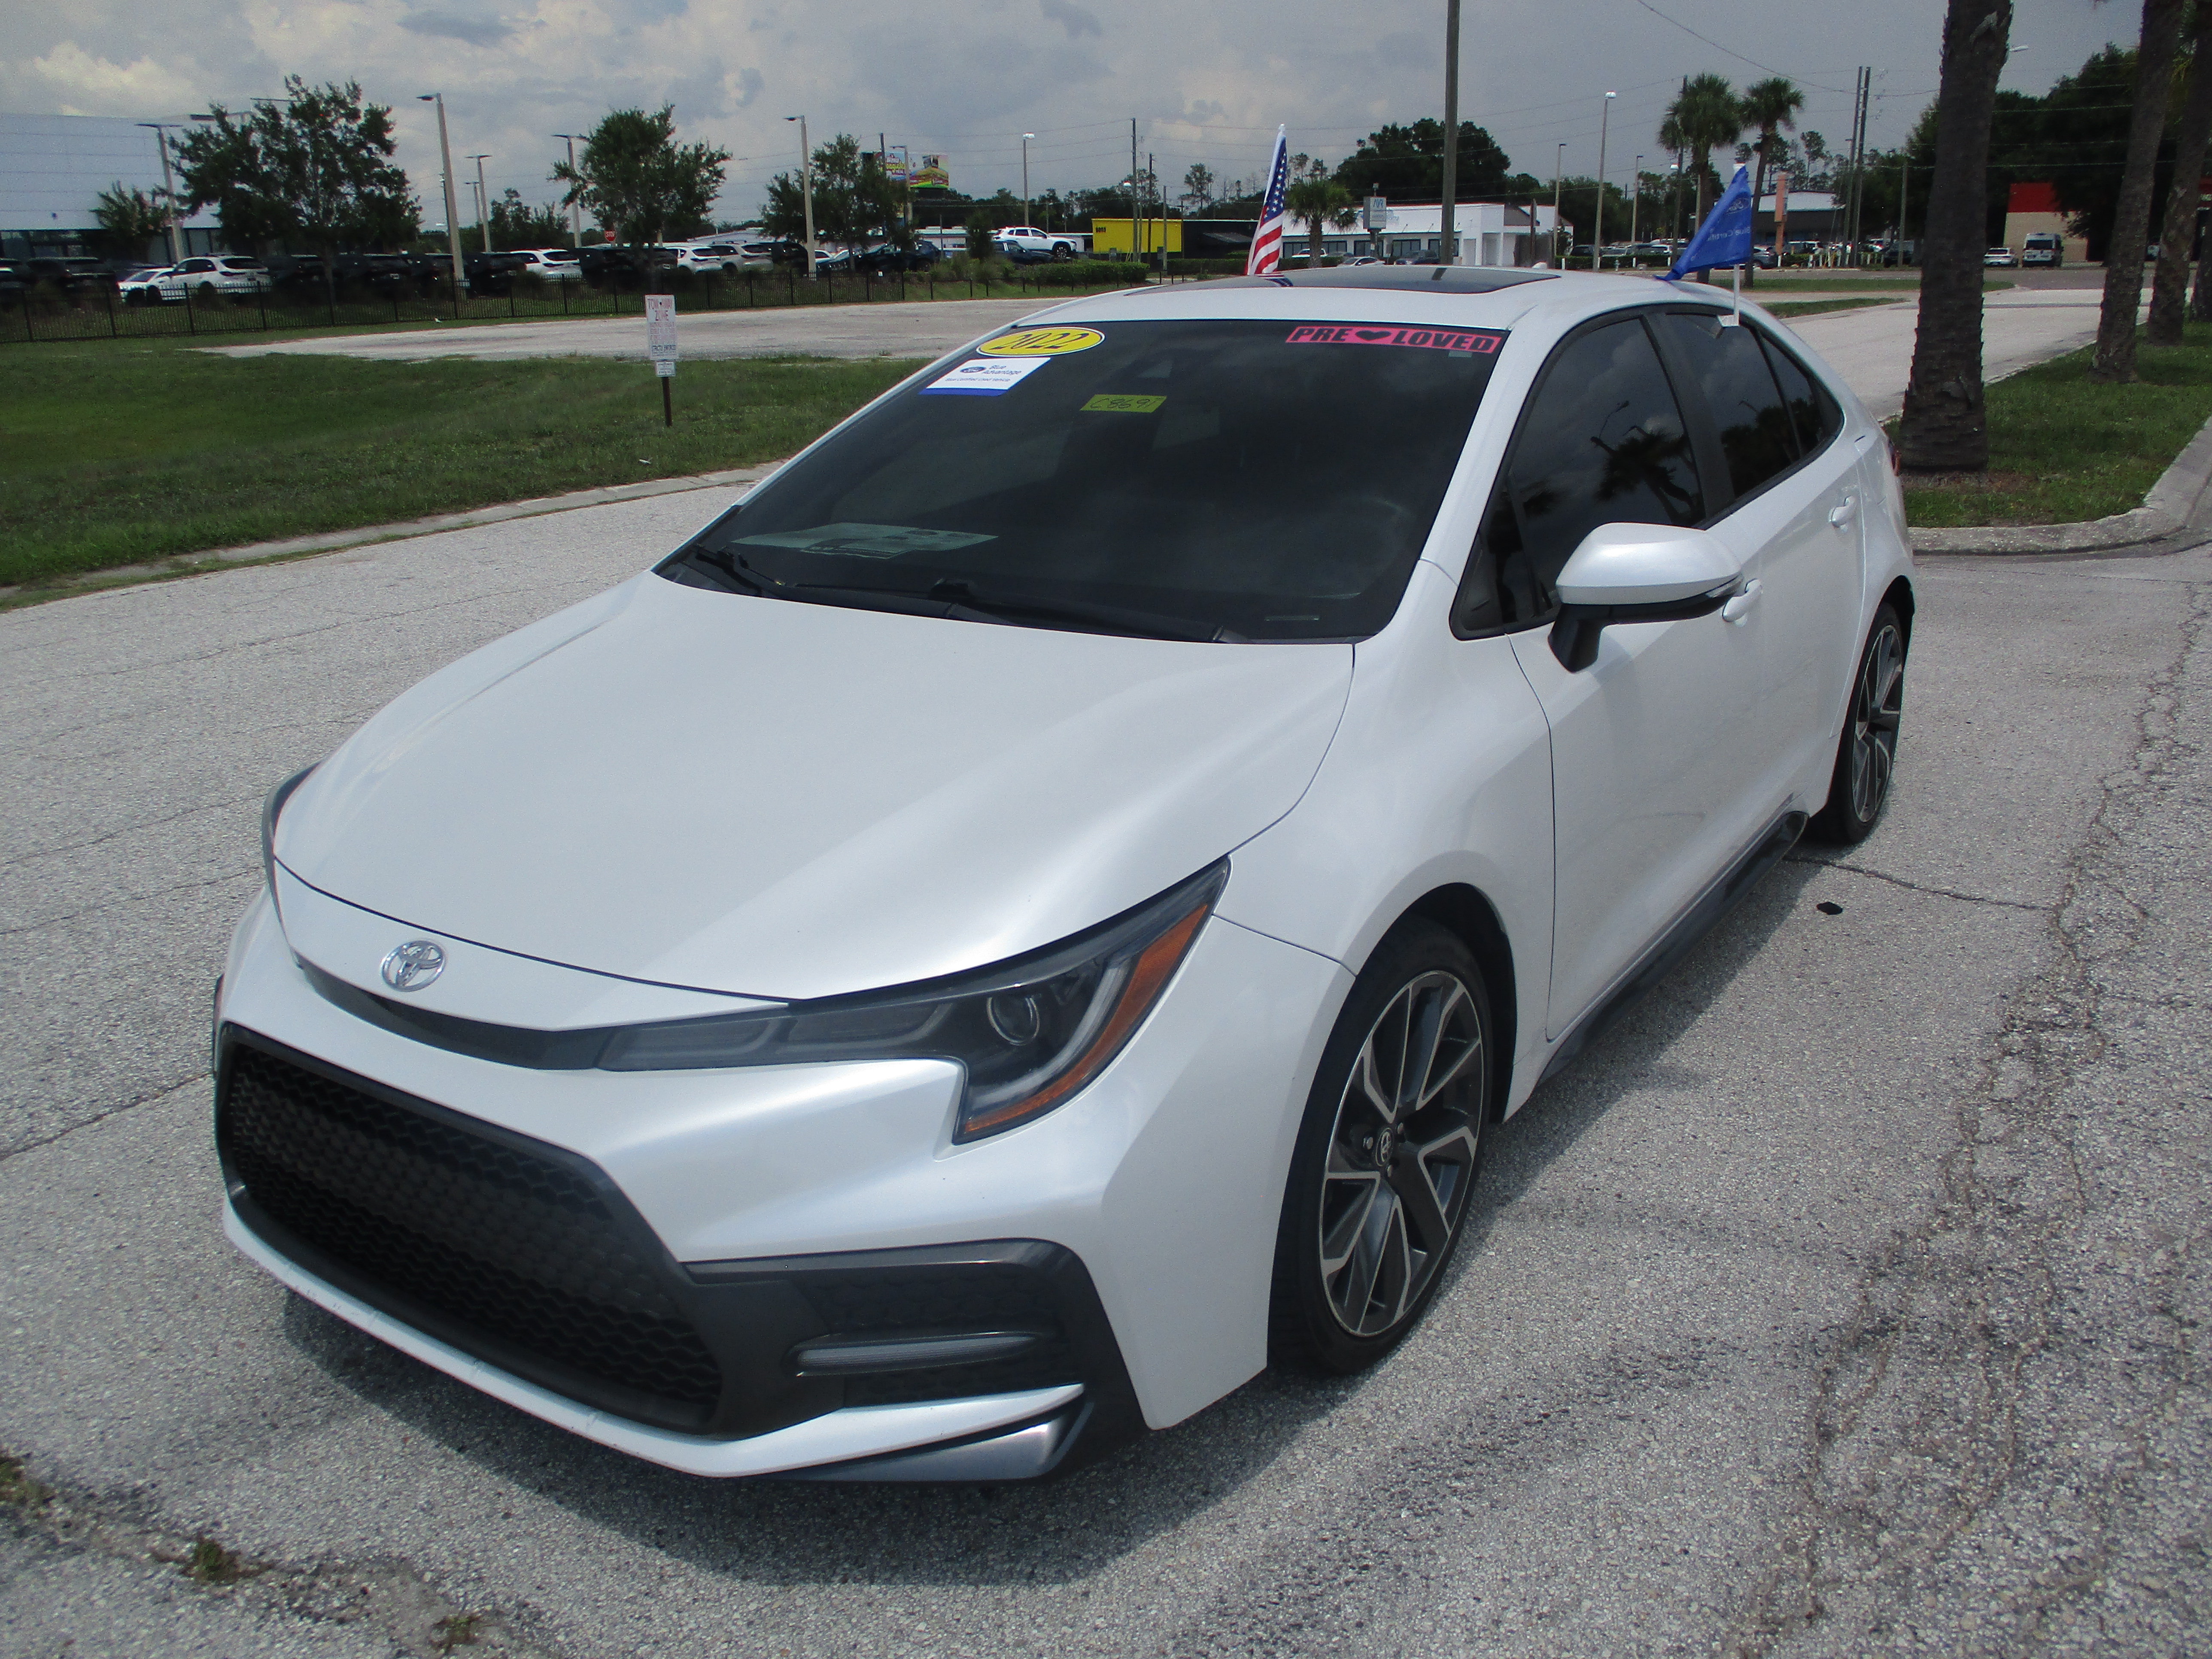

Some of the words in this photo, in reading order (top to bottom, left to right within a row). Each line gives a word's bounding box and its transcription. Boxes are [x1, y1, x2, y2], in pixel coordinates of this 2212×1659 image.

[989, 332, 1090, 349] 2022
[1290, 327, 1352, 342] PRE
[1392, 330, 1498, 351] LOVED
